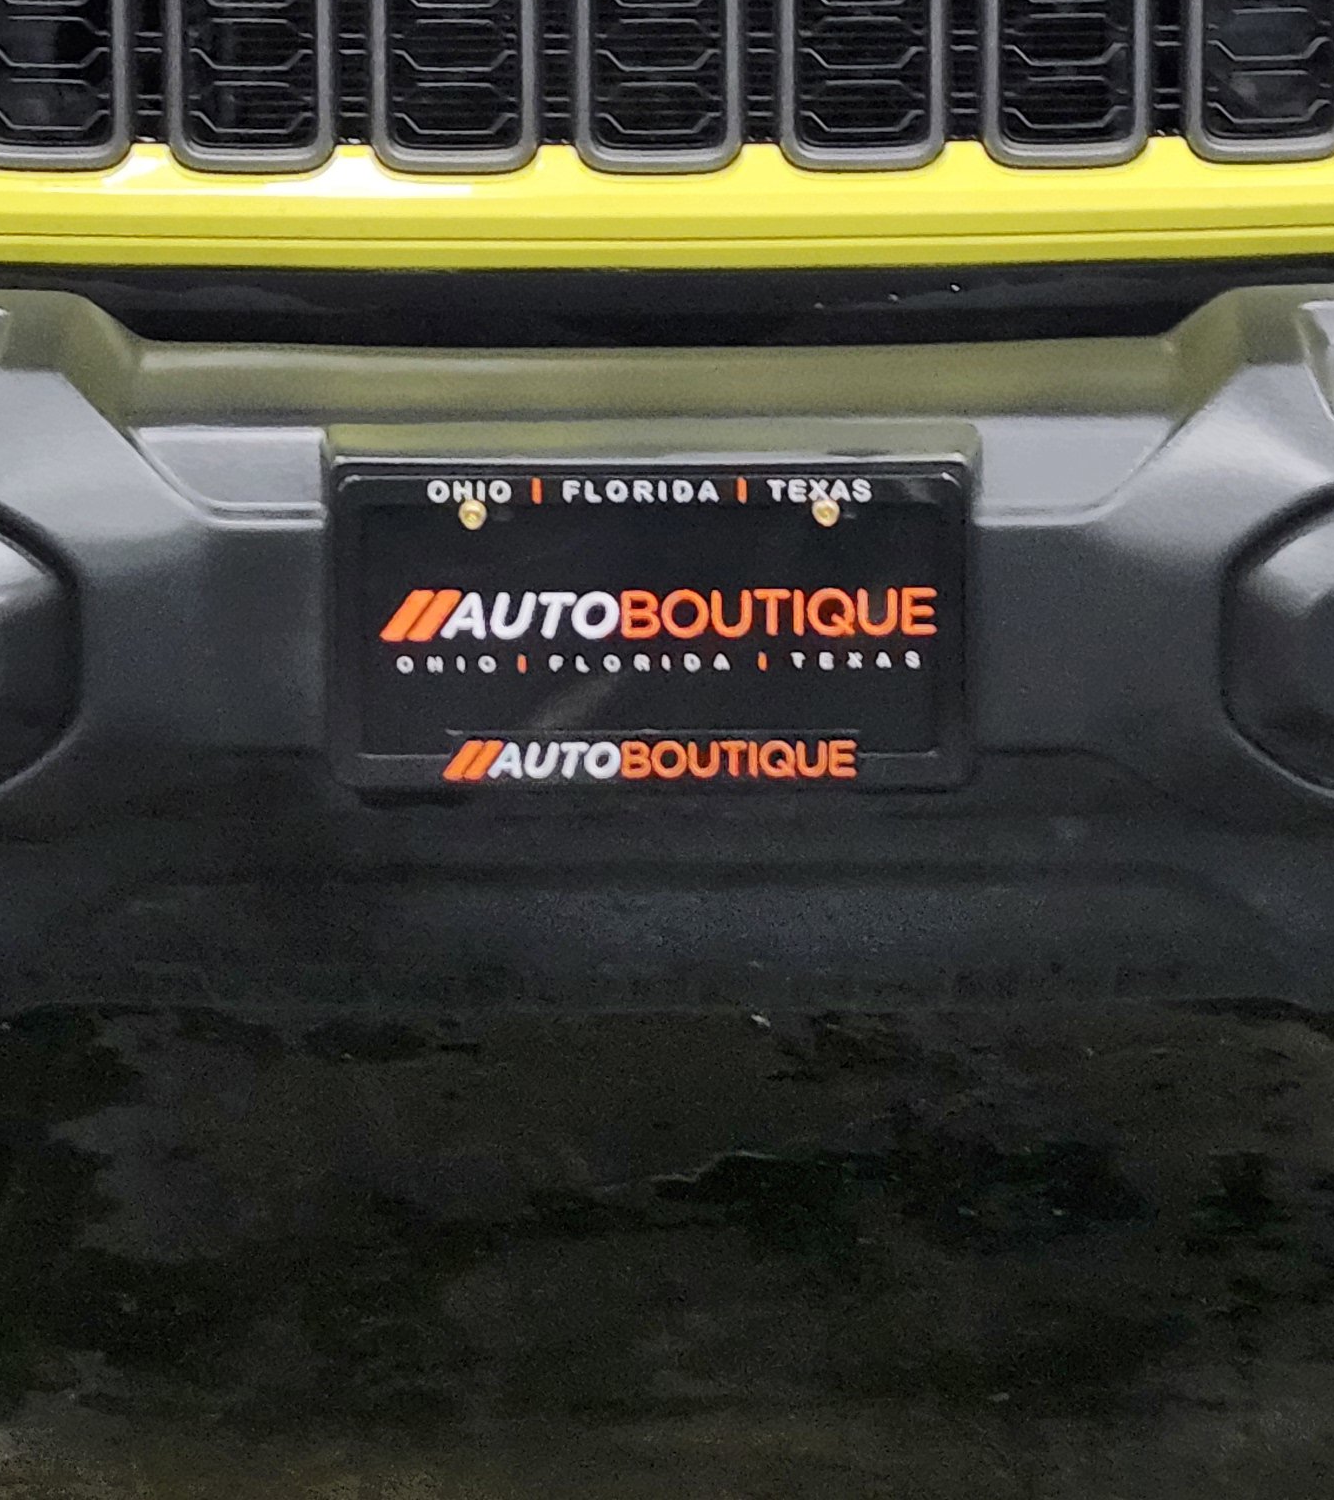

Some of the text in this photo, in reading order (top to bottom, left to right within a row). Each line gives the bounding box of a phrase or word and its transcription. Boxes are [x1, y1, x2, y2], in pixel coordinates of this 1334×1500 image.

[426, 477, 872, 503] OHIO FLORIDA TEXAS
[439, 587, 938, 641] AUTOBOUTIQUE
[395, 650, 922, 674] OHIO FLORIDA TEXAS
[486, 739, 858, 781] AUTOBOUTIQUE
